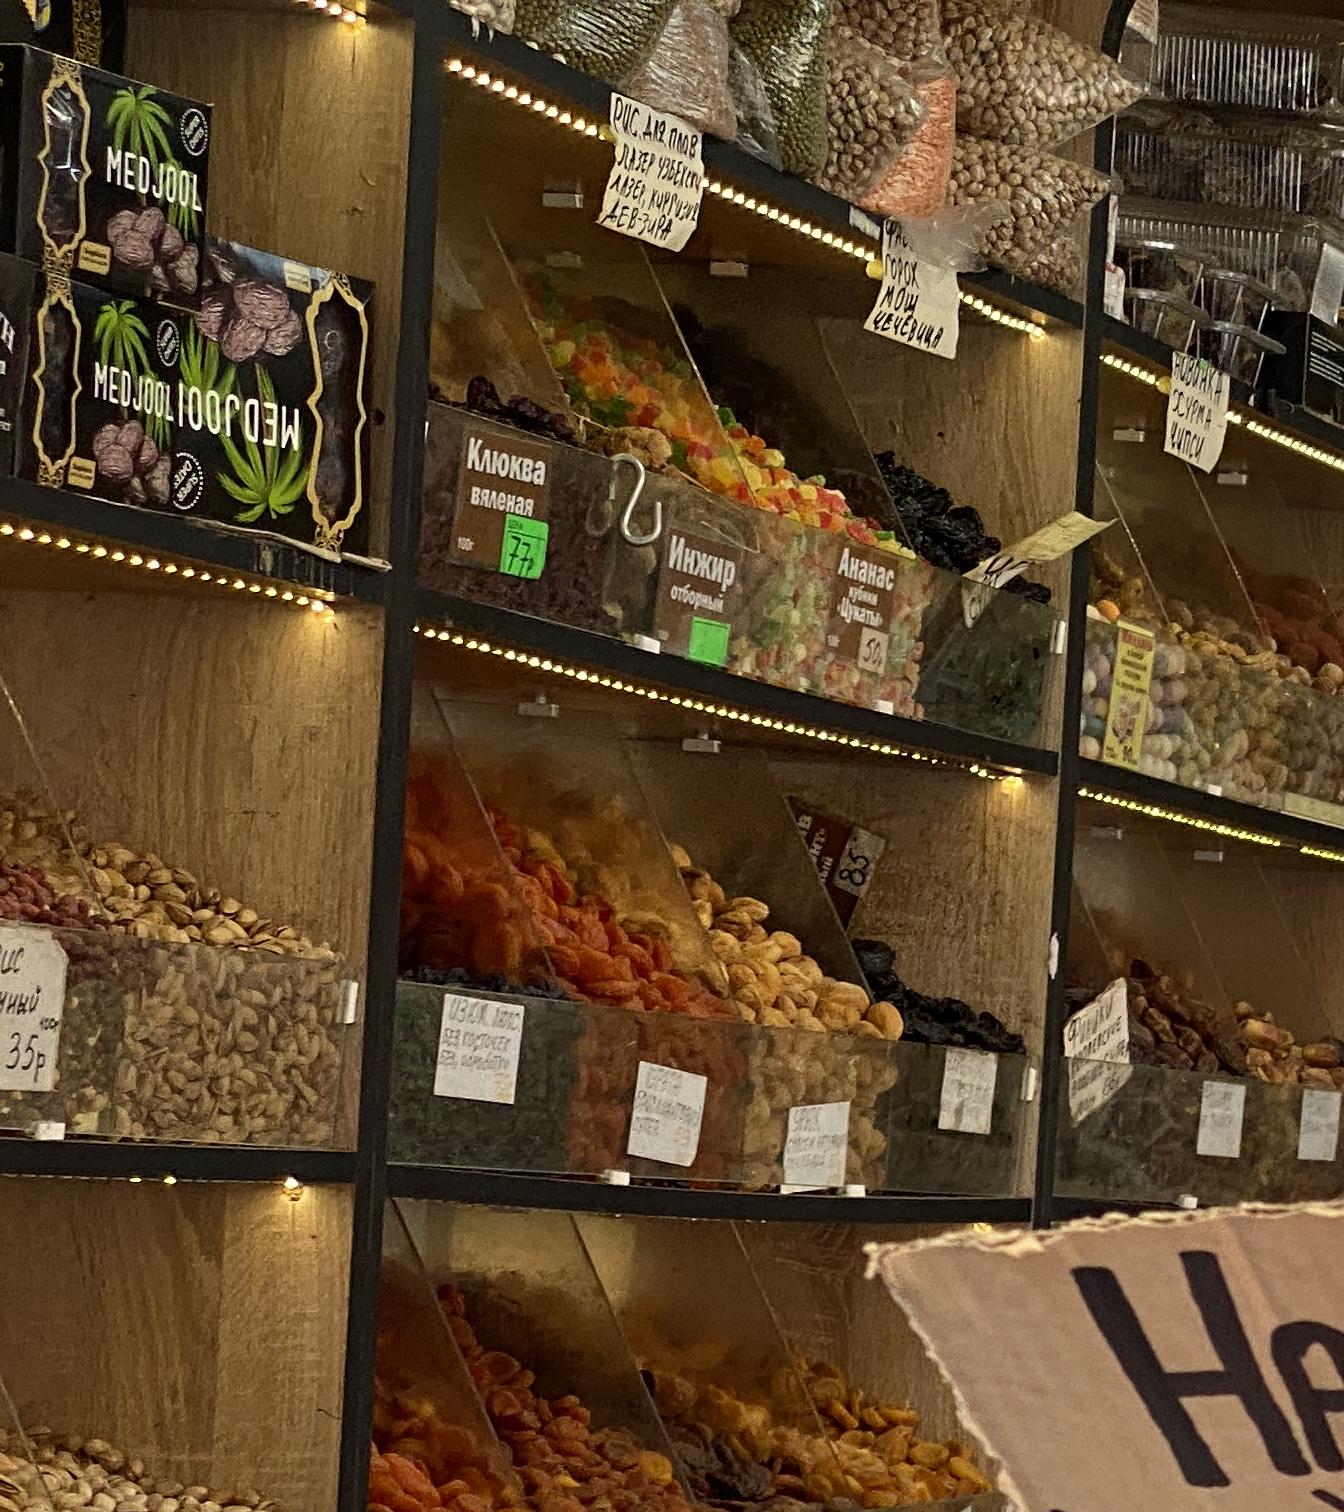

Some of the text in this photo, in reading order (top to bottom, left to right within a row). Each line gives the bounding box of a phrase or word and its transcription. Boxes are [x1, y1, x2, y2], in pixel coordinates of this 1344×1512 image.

[106, 145, 204, 213] MEDJOOL
[94, 361, 175, 423] MEDJOOL
[466, 436, 547, 487] Клюква
[469, 485, 535, 518] вяленая
[668, 535, 737, 593] Инжир
[837, 547, 896, 592] Ананас
